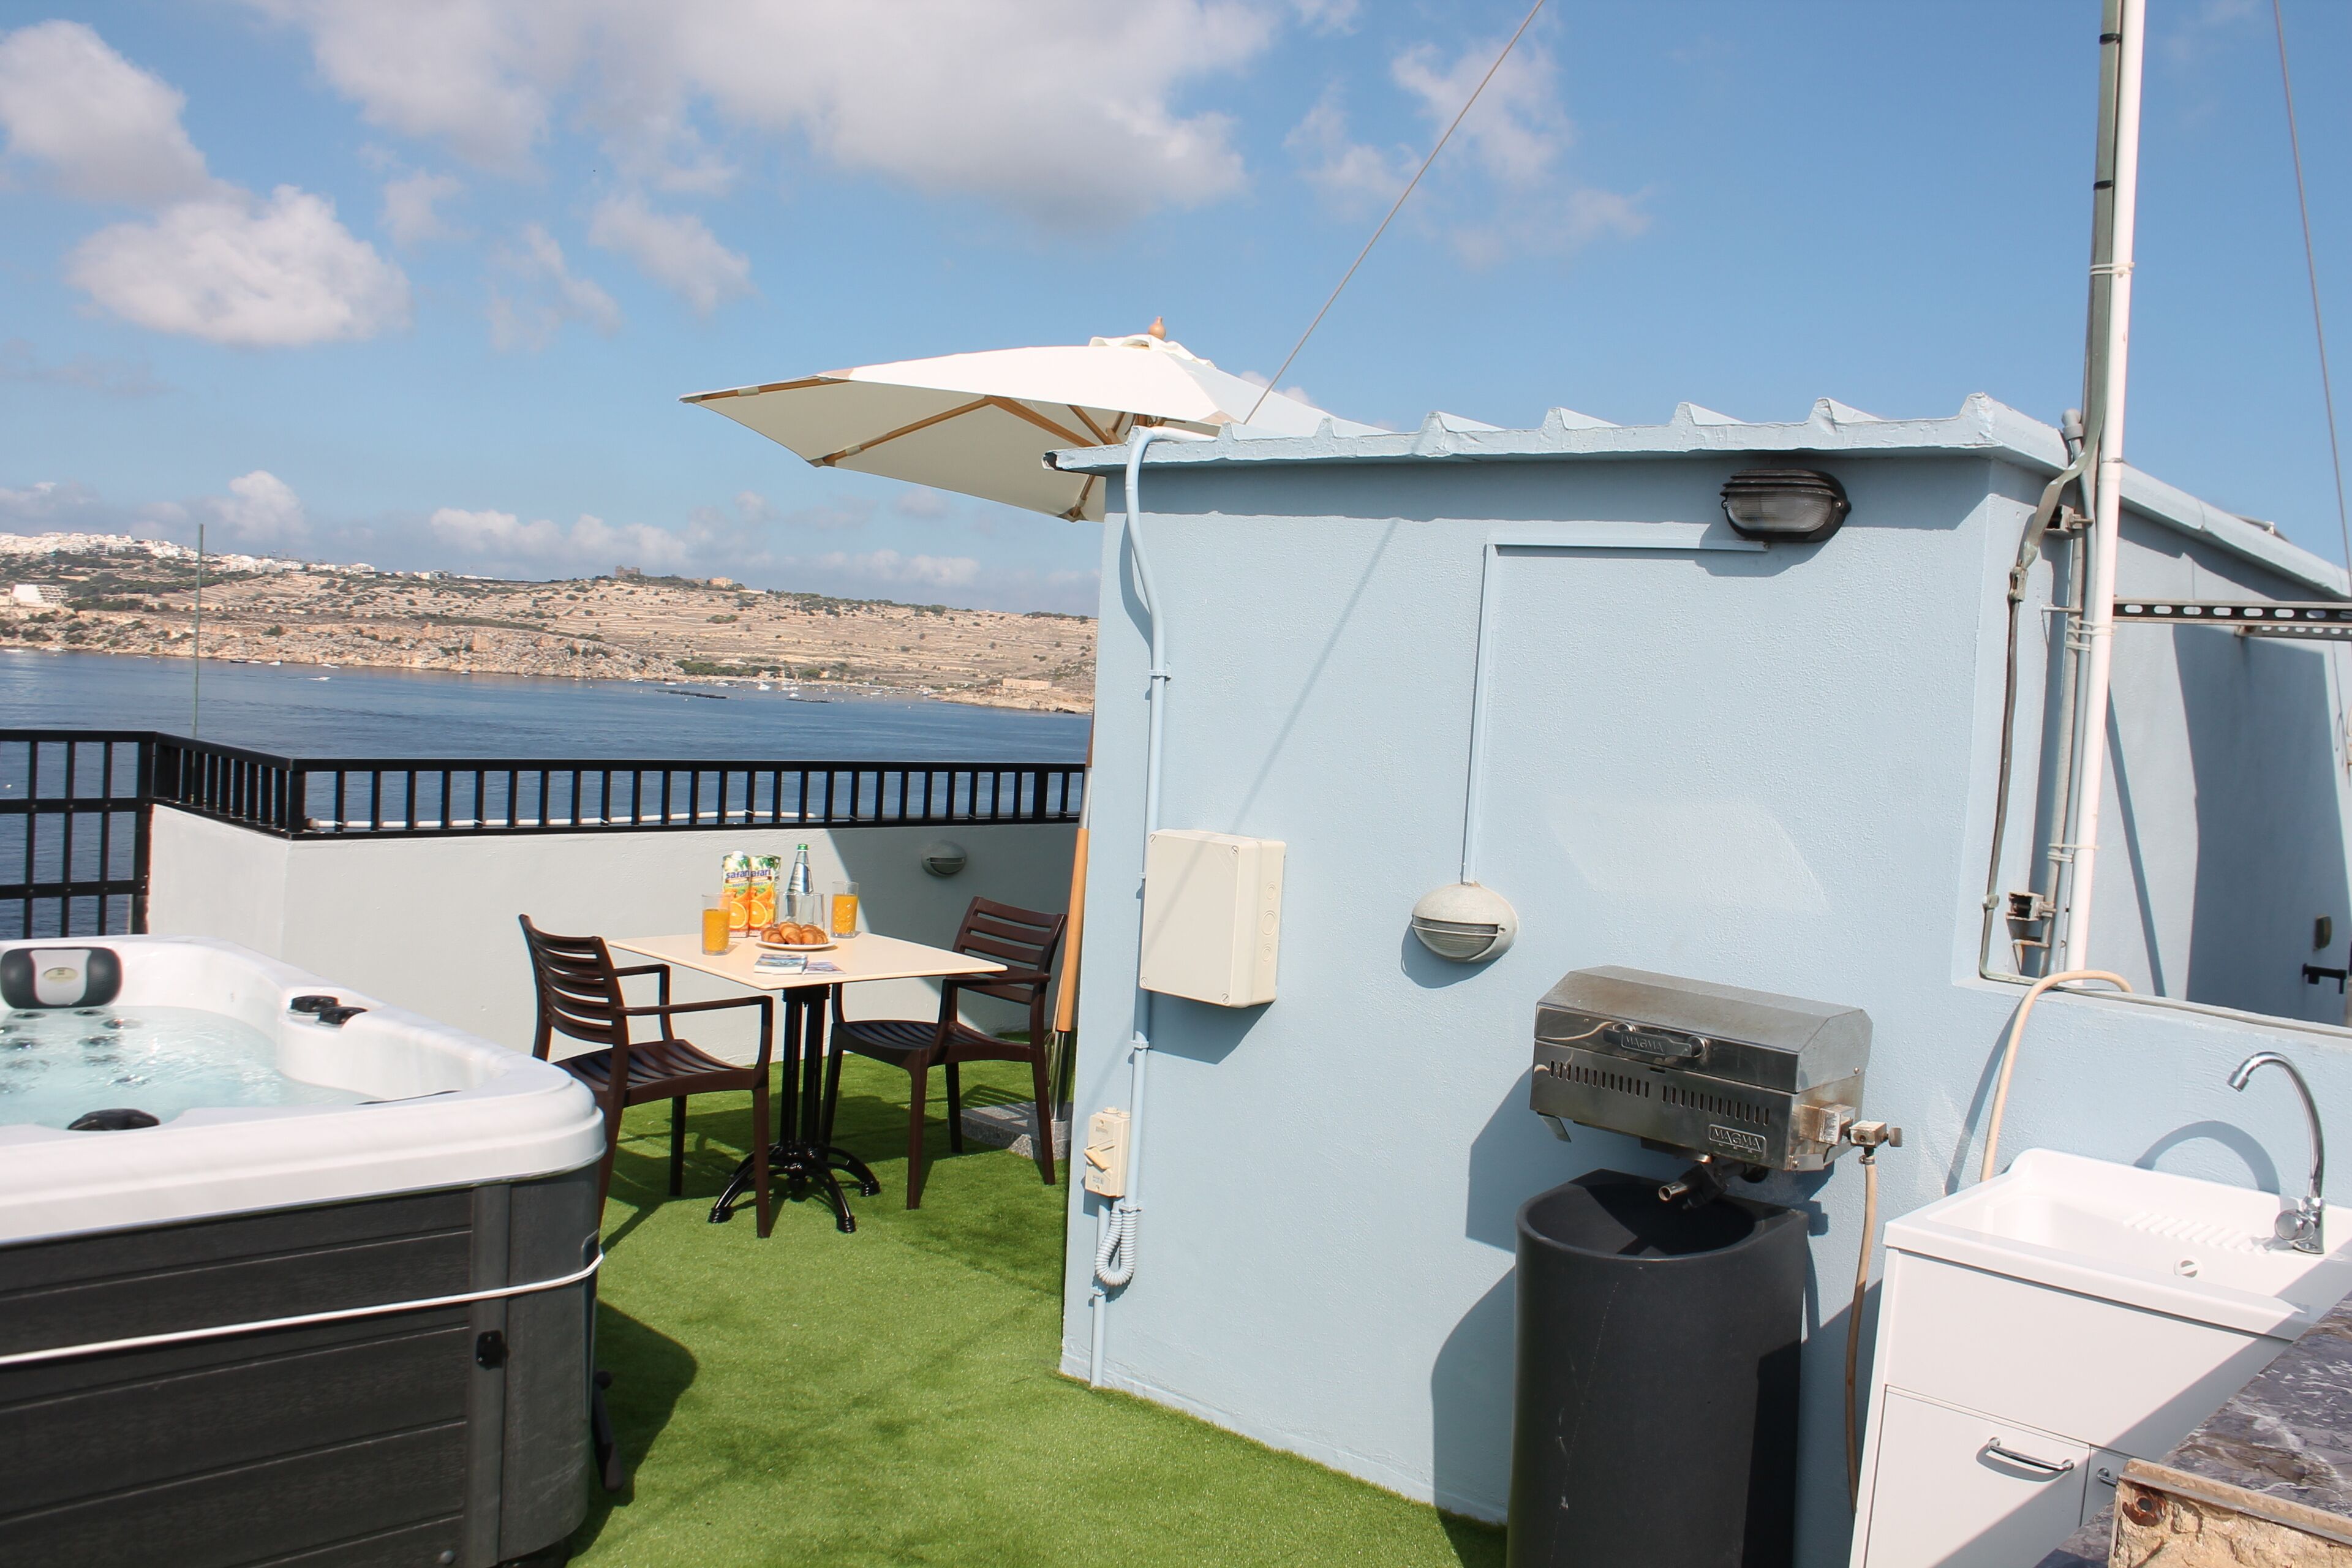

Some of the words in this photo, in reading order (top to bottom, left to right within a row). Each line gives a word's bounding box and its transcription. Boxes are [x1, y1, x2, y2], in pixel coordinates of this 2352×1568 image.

[750, 869, 771, 878] afari
[1624, 1035, 1664, 1053] MAGMA
[1712, 1128, 1761, 1150] MAGMA
